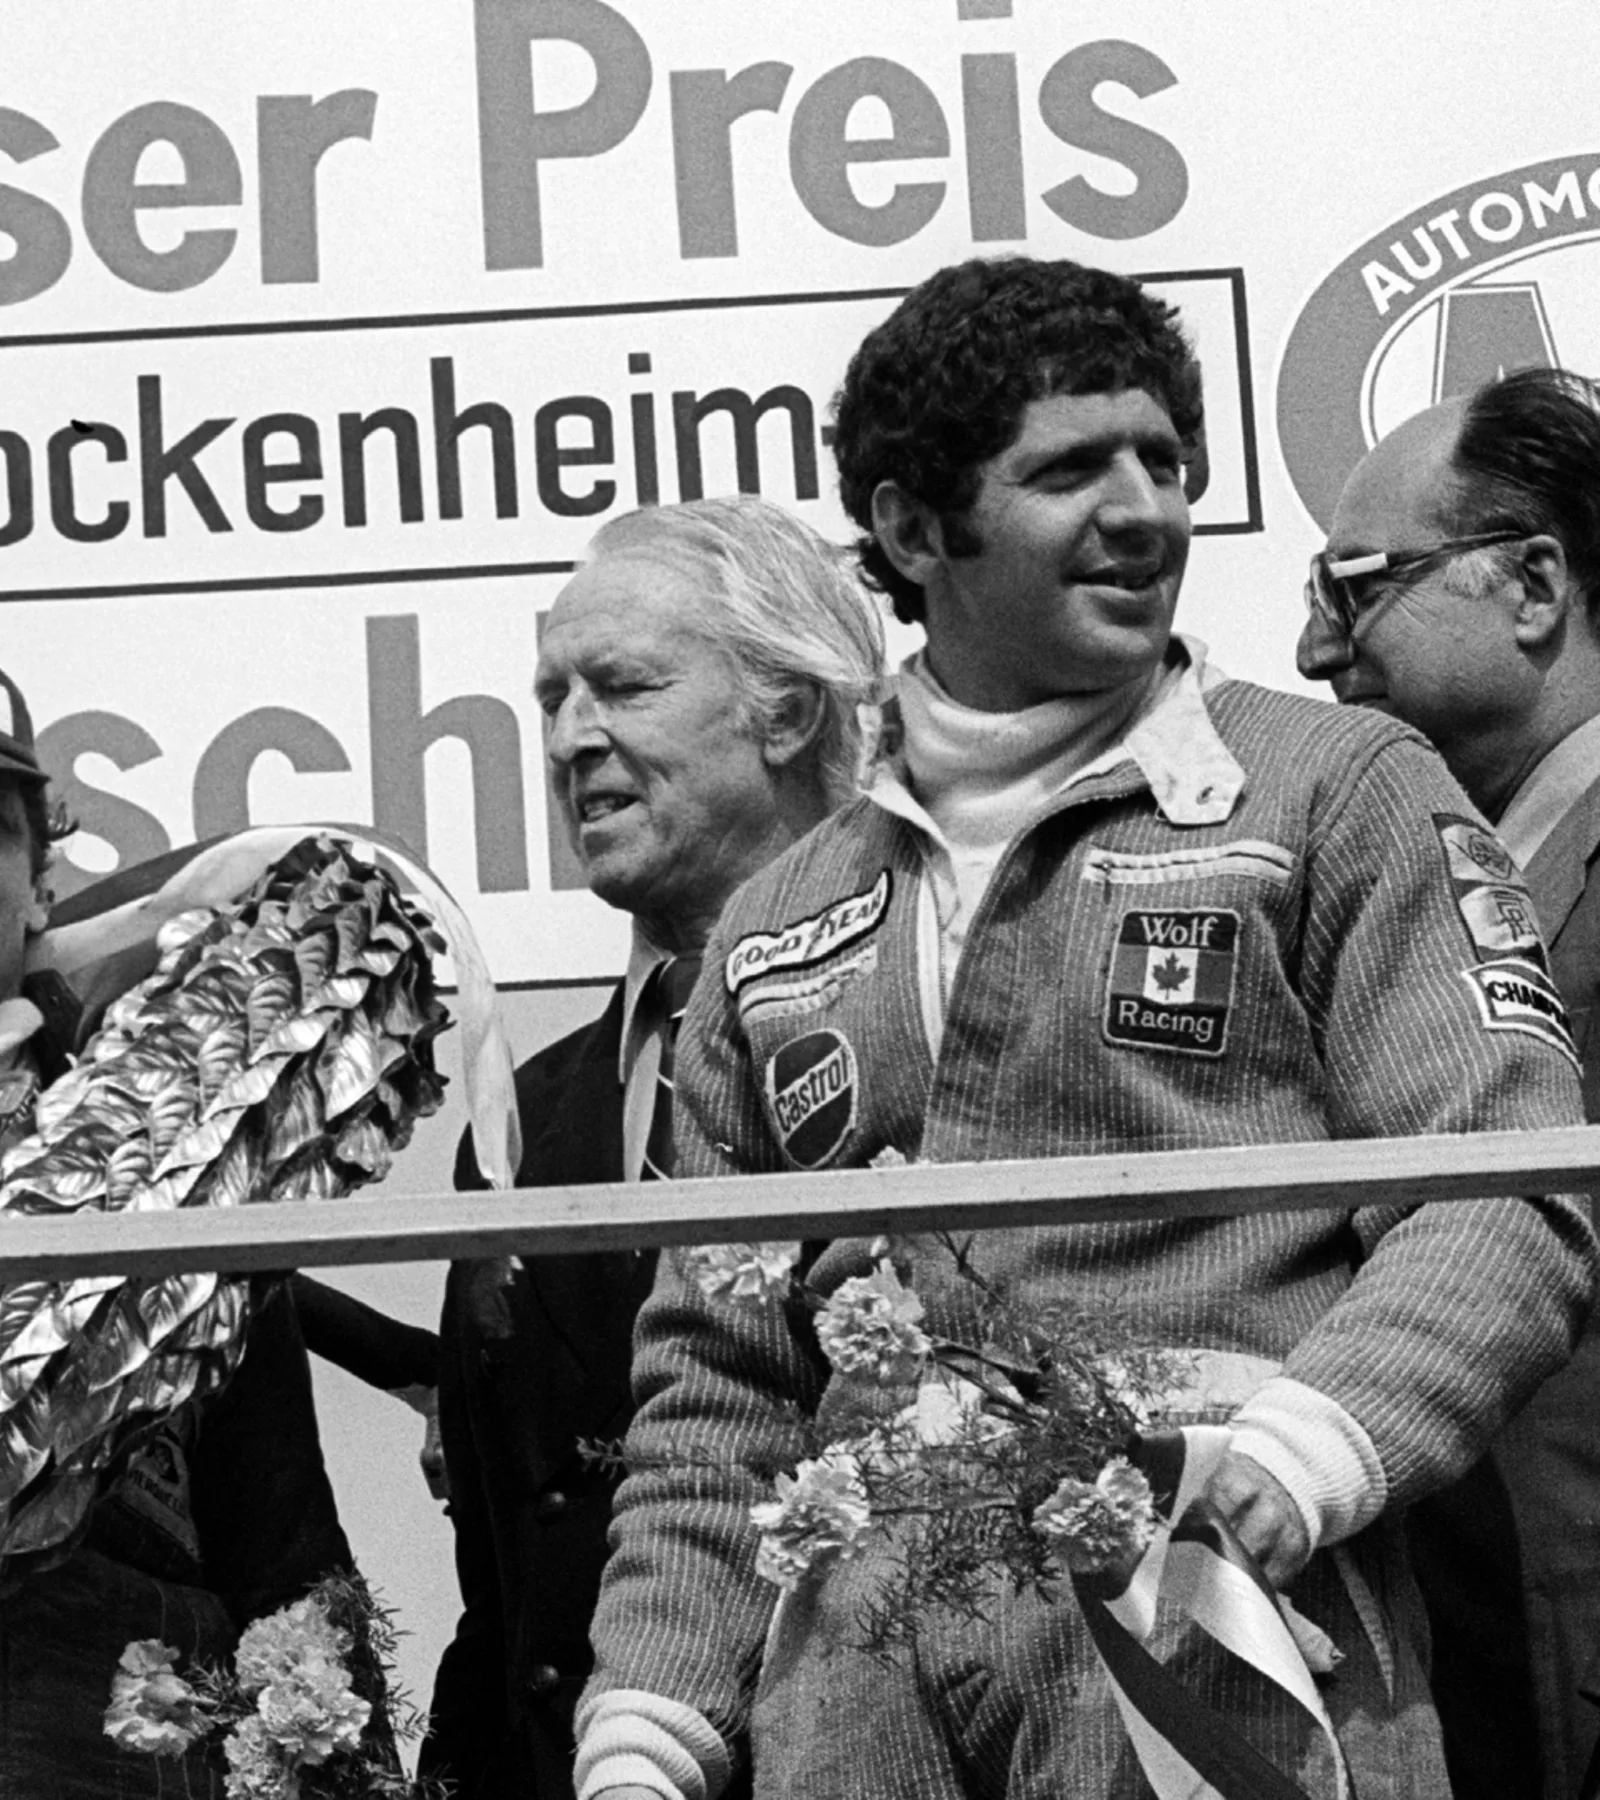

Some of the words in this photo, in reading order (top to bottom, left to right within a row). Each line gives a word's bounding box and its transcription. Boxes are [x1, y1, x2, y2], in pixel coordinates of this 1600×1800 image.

[473, 0, 1190, 272] Preis
[1360, 168, 1600, 316] AUTOM
[1140, 915, 1219, 947] Wolf
[1118, 1000, 1215, 1044] Racing
[775, 1045, 849, 1134] Castrol
